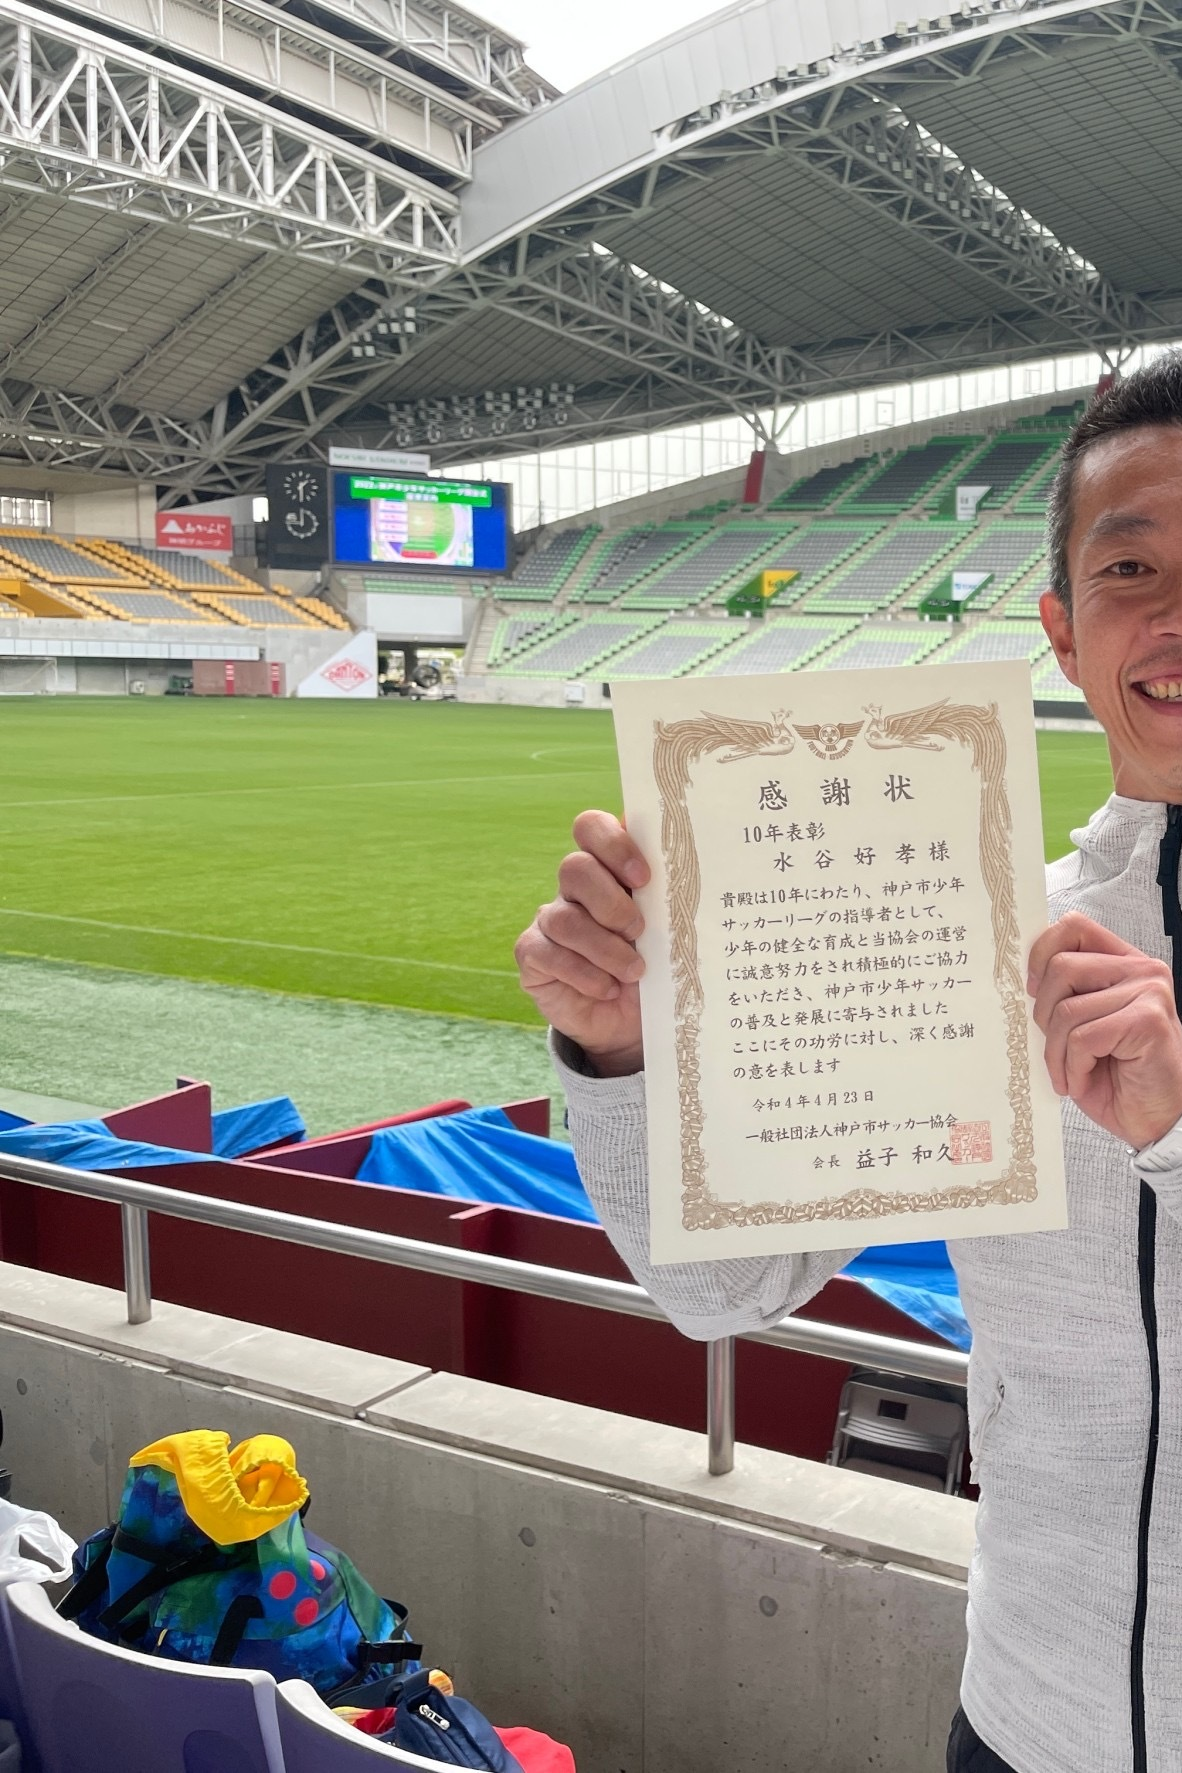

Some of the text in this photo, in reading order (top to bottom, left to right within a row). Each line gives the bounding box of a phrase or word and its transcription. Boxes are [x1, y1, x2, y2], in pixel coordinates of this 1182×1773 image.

[758, 774, 915, 811] 感謝状
[743, 821, 826, 843] 10年表彰
[724, 926, 967, 957] 少年の健全な育成と当協会の運営
[727, 951, 968, 980] に誠意努力をされ積極的にご協力
[730, 1001, 948, 1030] の普及と発展に寄与されました
[733, 1058, 840, 1080] の意を表します
[745, 1113, 959, 1142] 一般社団法人神戸市サッカー協会
[812, 1154, 841, 1169] 会長
